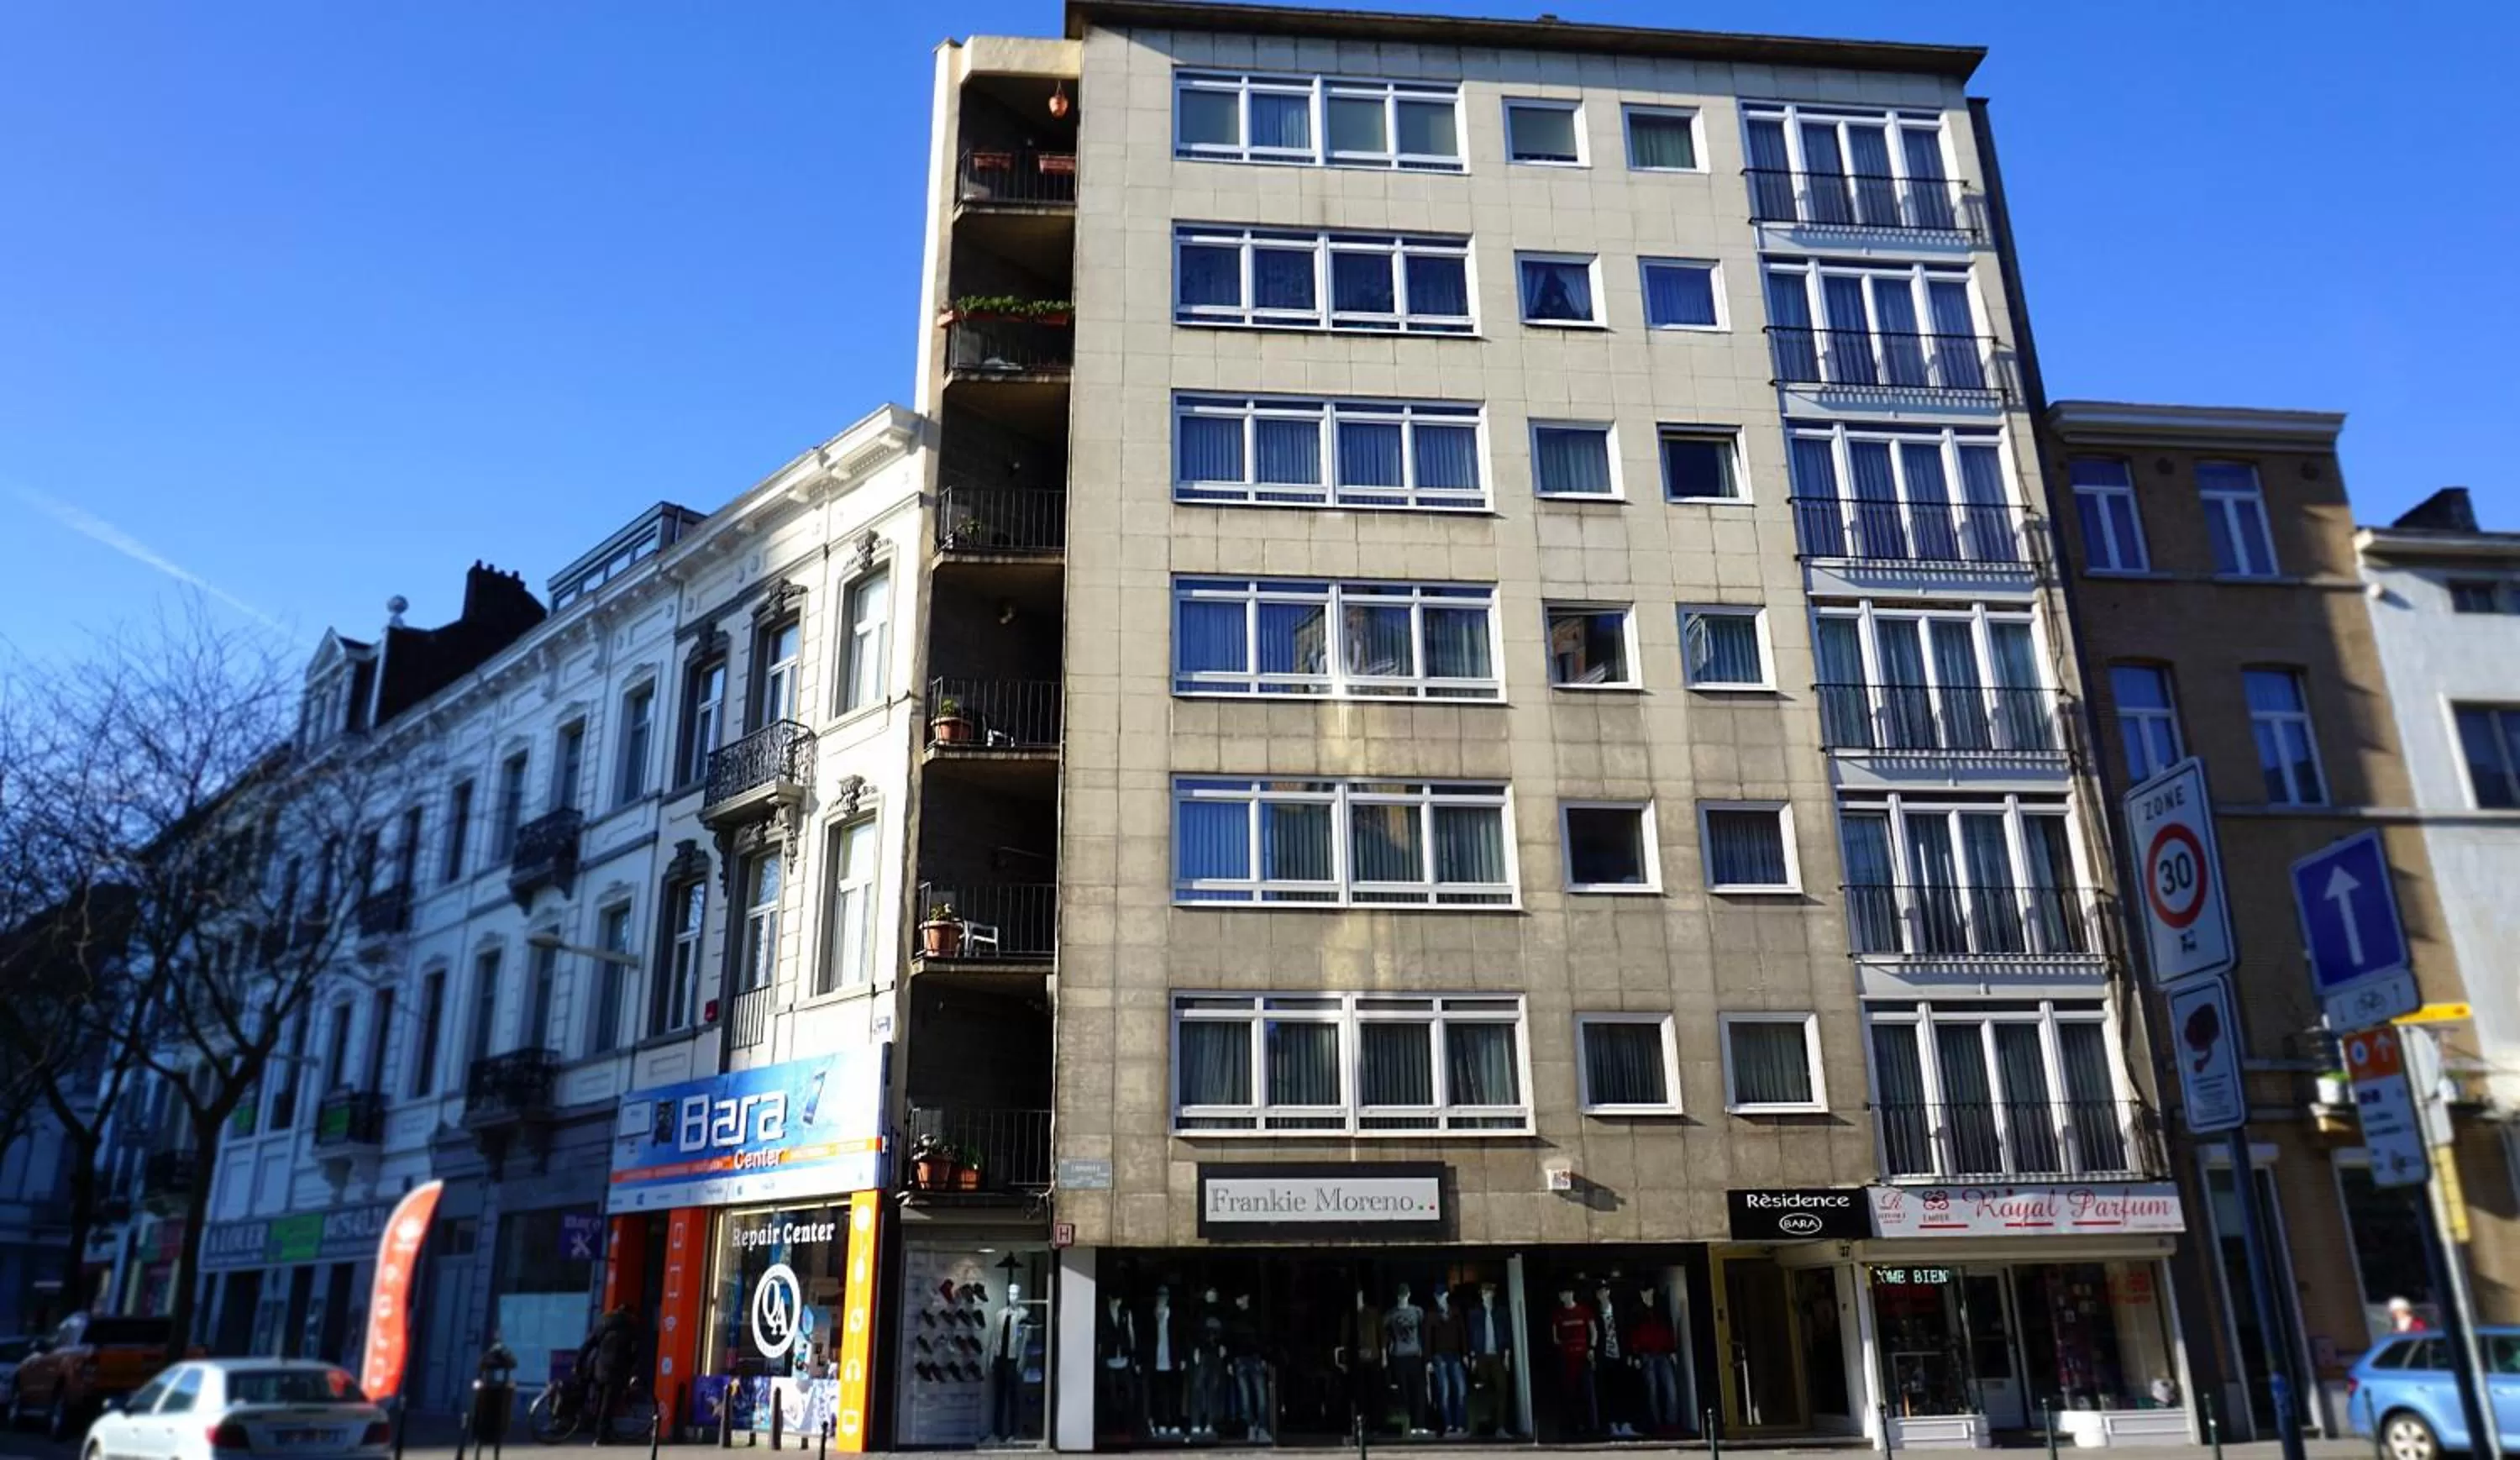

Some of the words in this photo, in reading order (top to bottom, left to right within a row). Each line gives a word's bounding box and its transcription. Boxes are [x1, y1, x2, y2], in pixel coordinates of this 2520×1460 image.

[2144, 785, 2185, 821] ZONE
[2159, 851, 2192, 895] 30
[679, 1091, 788, 1153] Bara
[732, 1148, 783, 1170] Center
[1210, 1187, 1306, 1213] Frankie
[1961, 1188, 2059, 1223] Royal
[2066, 1187, 2171, 1226] Parfum
[732, 1222, 780, 1251] Repair
[783, 1222, 836, 1244] Center
[1783, 1219, 1819, 1229] BARA
[1913, 1268, 1950, 1284] BIEN
